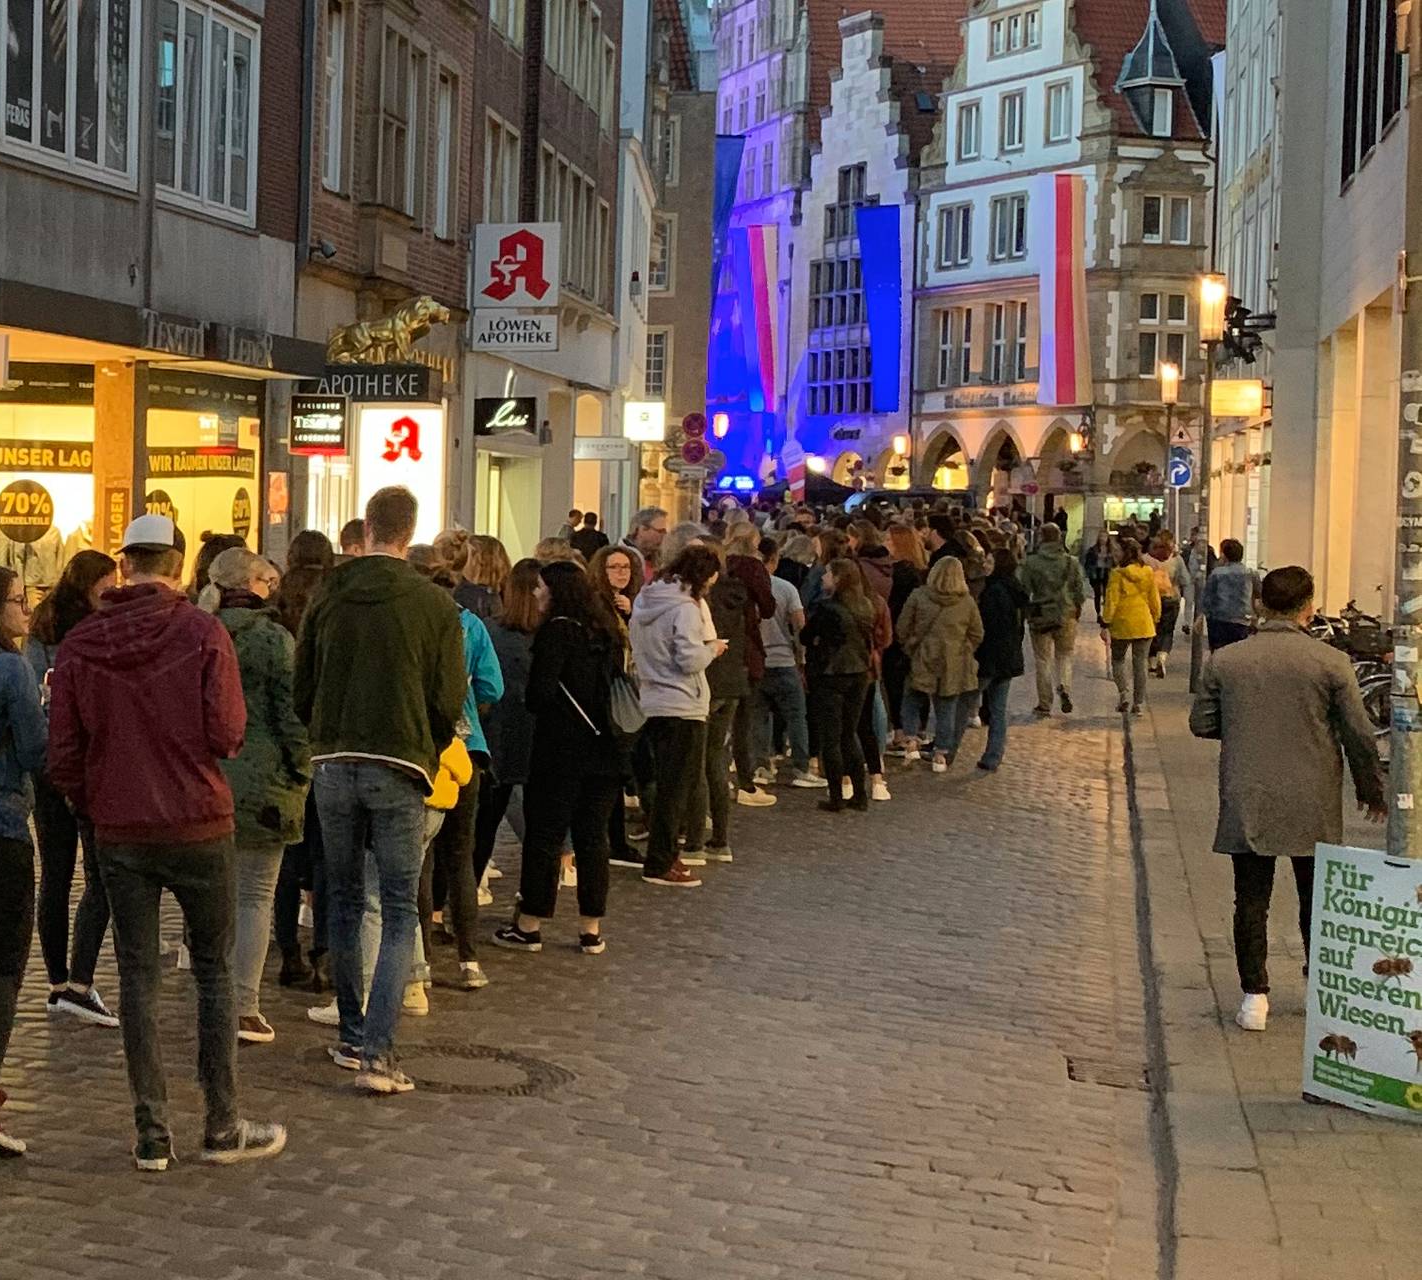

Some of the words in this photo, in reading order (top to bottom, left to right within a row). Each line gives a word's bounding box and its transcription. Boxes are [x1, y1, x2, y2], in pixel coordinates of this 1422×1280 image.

[489, 317, 541, 331] LÖWEN
[478, 331, 552, 344] APOTHEKE
[317, 373, 419, 396] APOTHEKE
[58, 450, 92, 468] LAG
[148, 455, 172, 472] WIR
[1, 492, 51, 514] 70%
[110, 492, 125, 544] LAGER
[1324, 860, 1374, 891] Für
[1319, 945, 1357, 970] auf
[1318, 968, 1422, 1010] unseren
